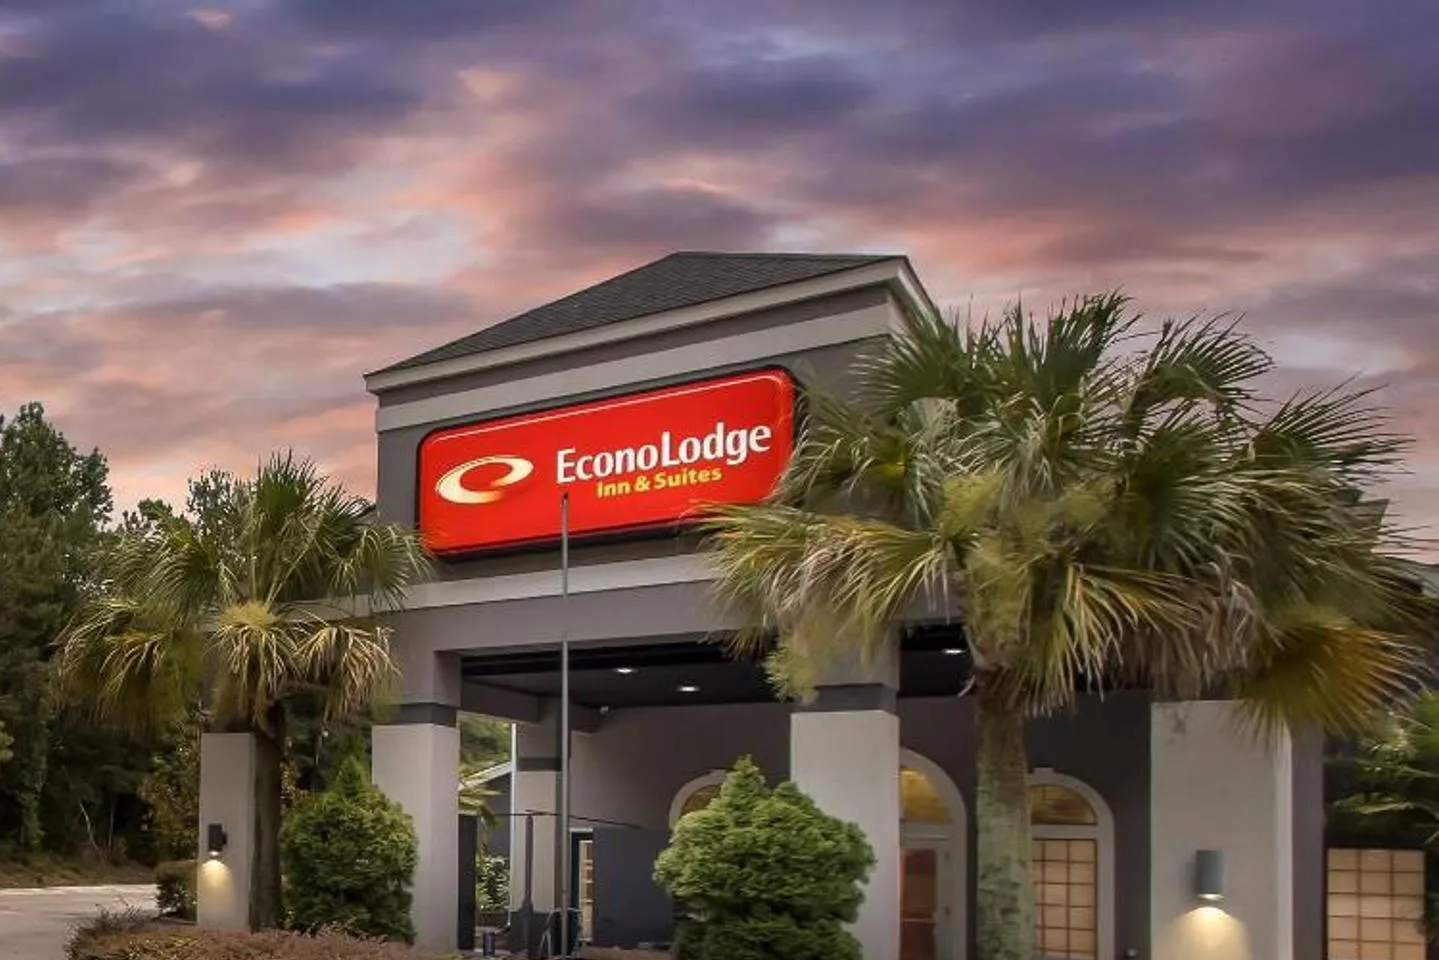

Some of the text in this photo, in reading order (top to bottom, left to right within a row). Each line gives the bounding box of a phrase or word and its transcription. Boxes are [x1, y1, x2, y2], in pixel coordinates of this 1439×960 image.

[596, 467, 723, 498] Inn & Suites
